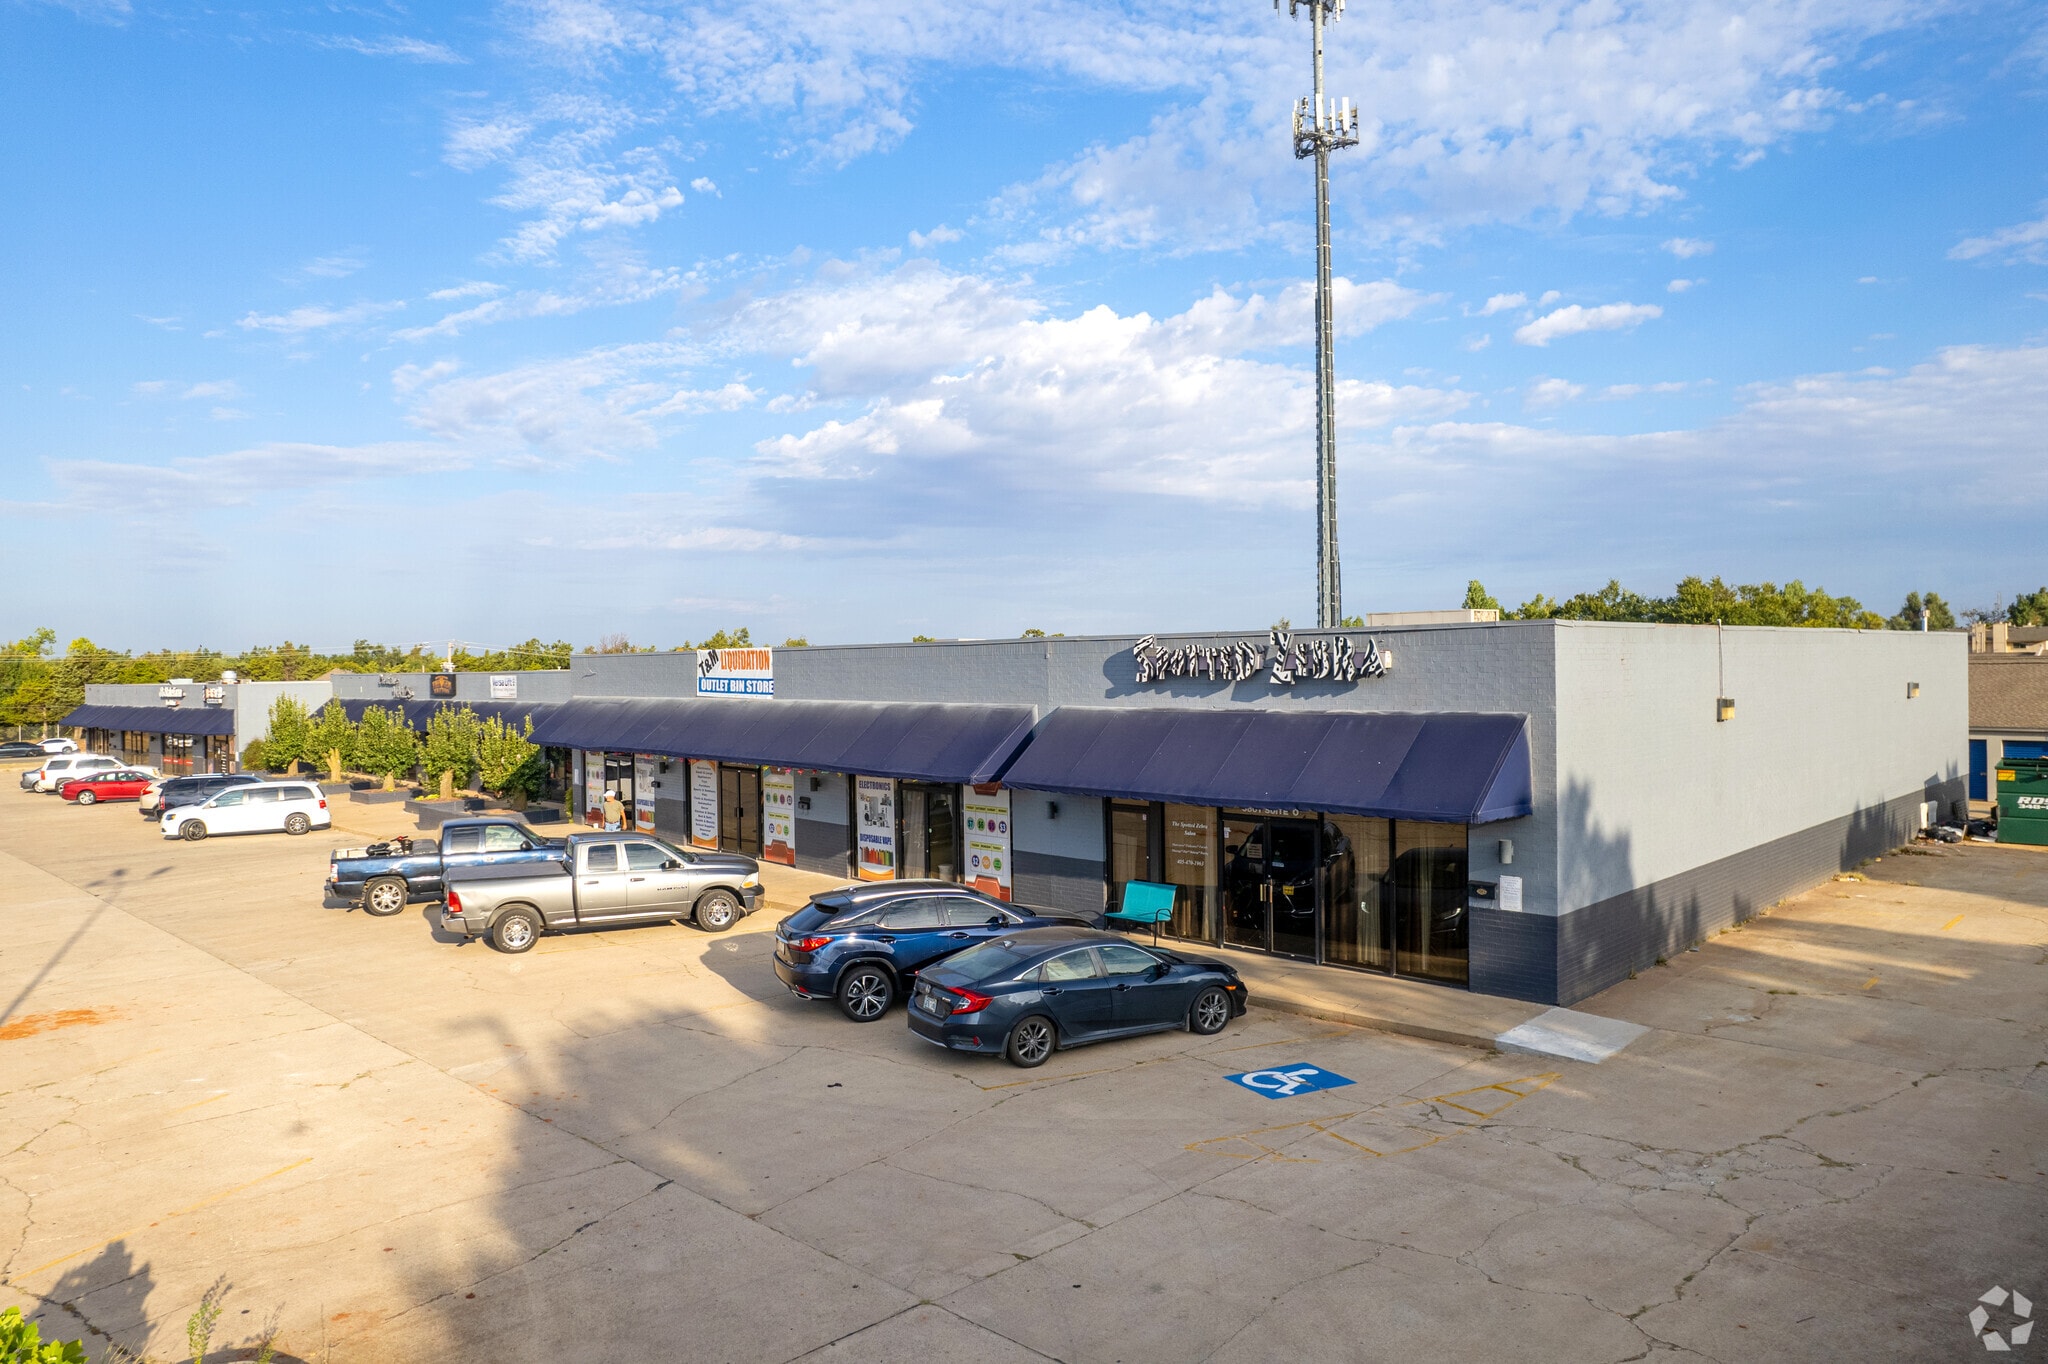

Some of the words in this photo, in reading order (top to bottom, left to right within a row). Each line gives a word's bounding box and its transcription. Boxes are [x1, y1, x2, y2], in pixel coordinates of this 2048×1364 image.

[699, 649, 719, 677] T&M
[720, 650, 770, 672] LIQUIDATION
[701, 679, 729, 691] OUTLET
[730, 680, 745, 692] BIN
[746, 680, 774, 693] STORE
[859, 780, 891, 791] ELECTRONICS
[860, 833, 882, 844] DISPOSABLE
[882, 835, 892, 845] VAPE
